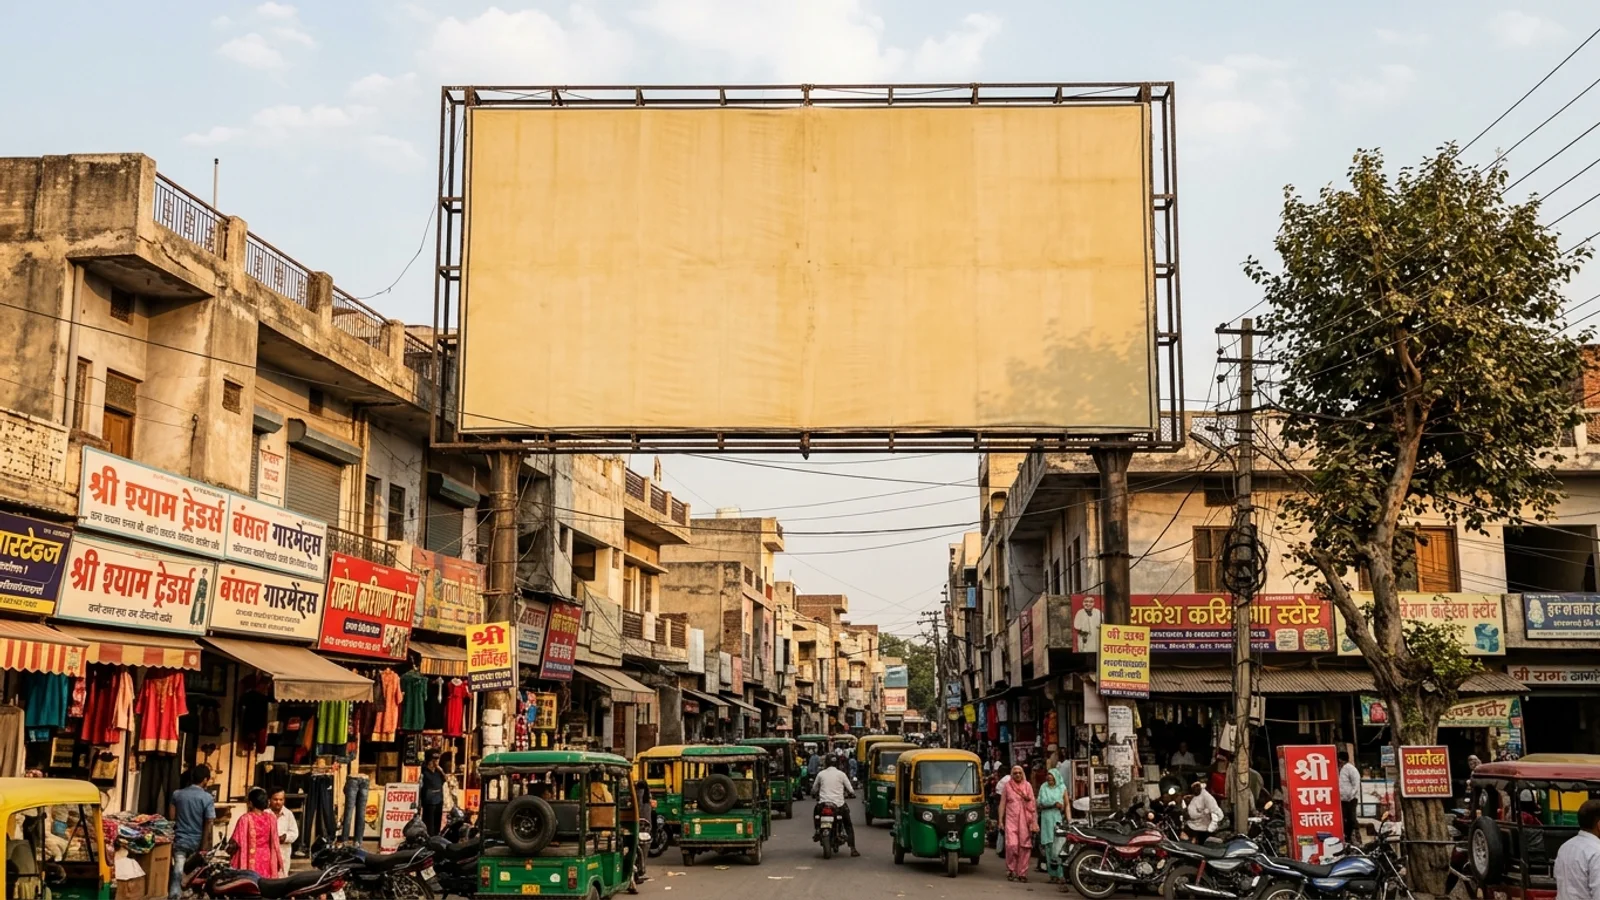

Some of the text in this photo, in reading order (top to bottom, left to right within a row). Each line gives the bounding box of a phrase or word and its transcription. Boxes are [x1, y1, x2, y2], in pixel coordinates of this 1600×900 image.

[88, 465, 120, 506] श्री
[125, 481, 179, 521] श्याम
[232, 505, 270, 542] बंसल
[70, 549, 100, 591] श्री
[102, 563, 153, 600] श्याम
[220, 569, 262, 605] बंसल
[1276, 597, 1321, 624] स्टोर
[472, 625, 506, 645] श्री
[1294, 753, 1331, 781] श्री
[1296, 787, 1333, 805] राम
